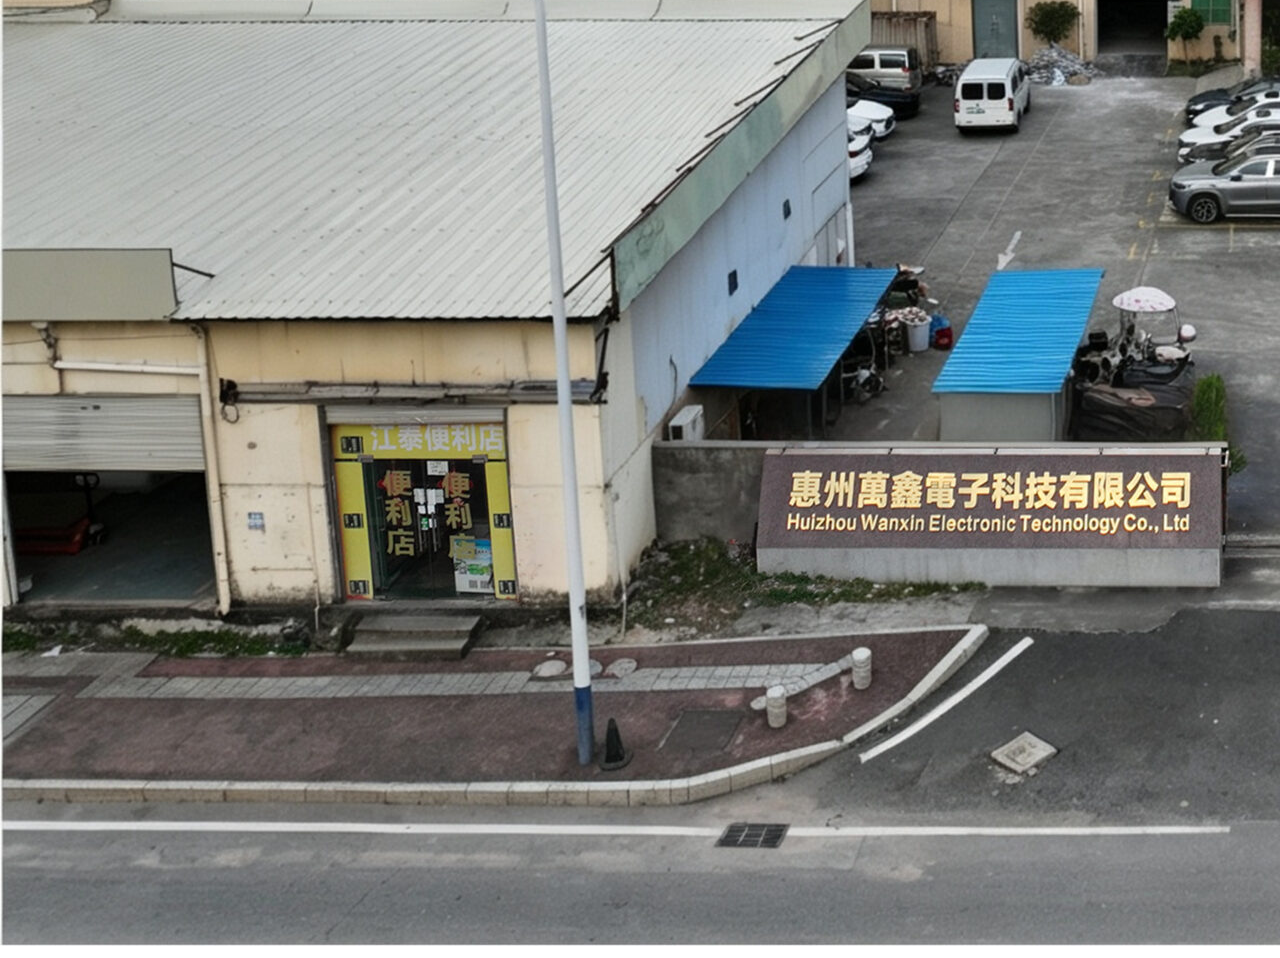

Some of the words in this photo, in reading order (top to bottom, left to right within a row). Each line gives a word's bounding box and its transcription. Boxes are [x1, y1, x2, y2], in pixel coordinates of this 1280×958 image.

[372, 424, 504, 451] 江泰便利店
[789, 470, 1191, 510] 惠州萬鑫電子科技有限公司
[384, 470, 415, 556] 便利店
[442, 472, 476, 558] 便利店
[787, 513, 857, 532] Huizhou
[861, 514, 925, 532] Wanxin
[929, 515, 1016, 532] Electronic
[1020, 514, 1120, 534] Technology
[1123, 514, 1159, 534] Co.,
[1163, 514, 1190, 531] Ltd
